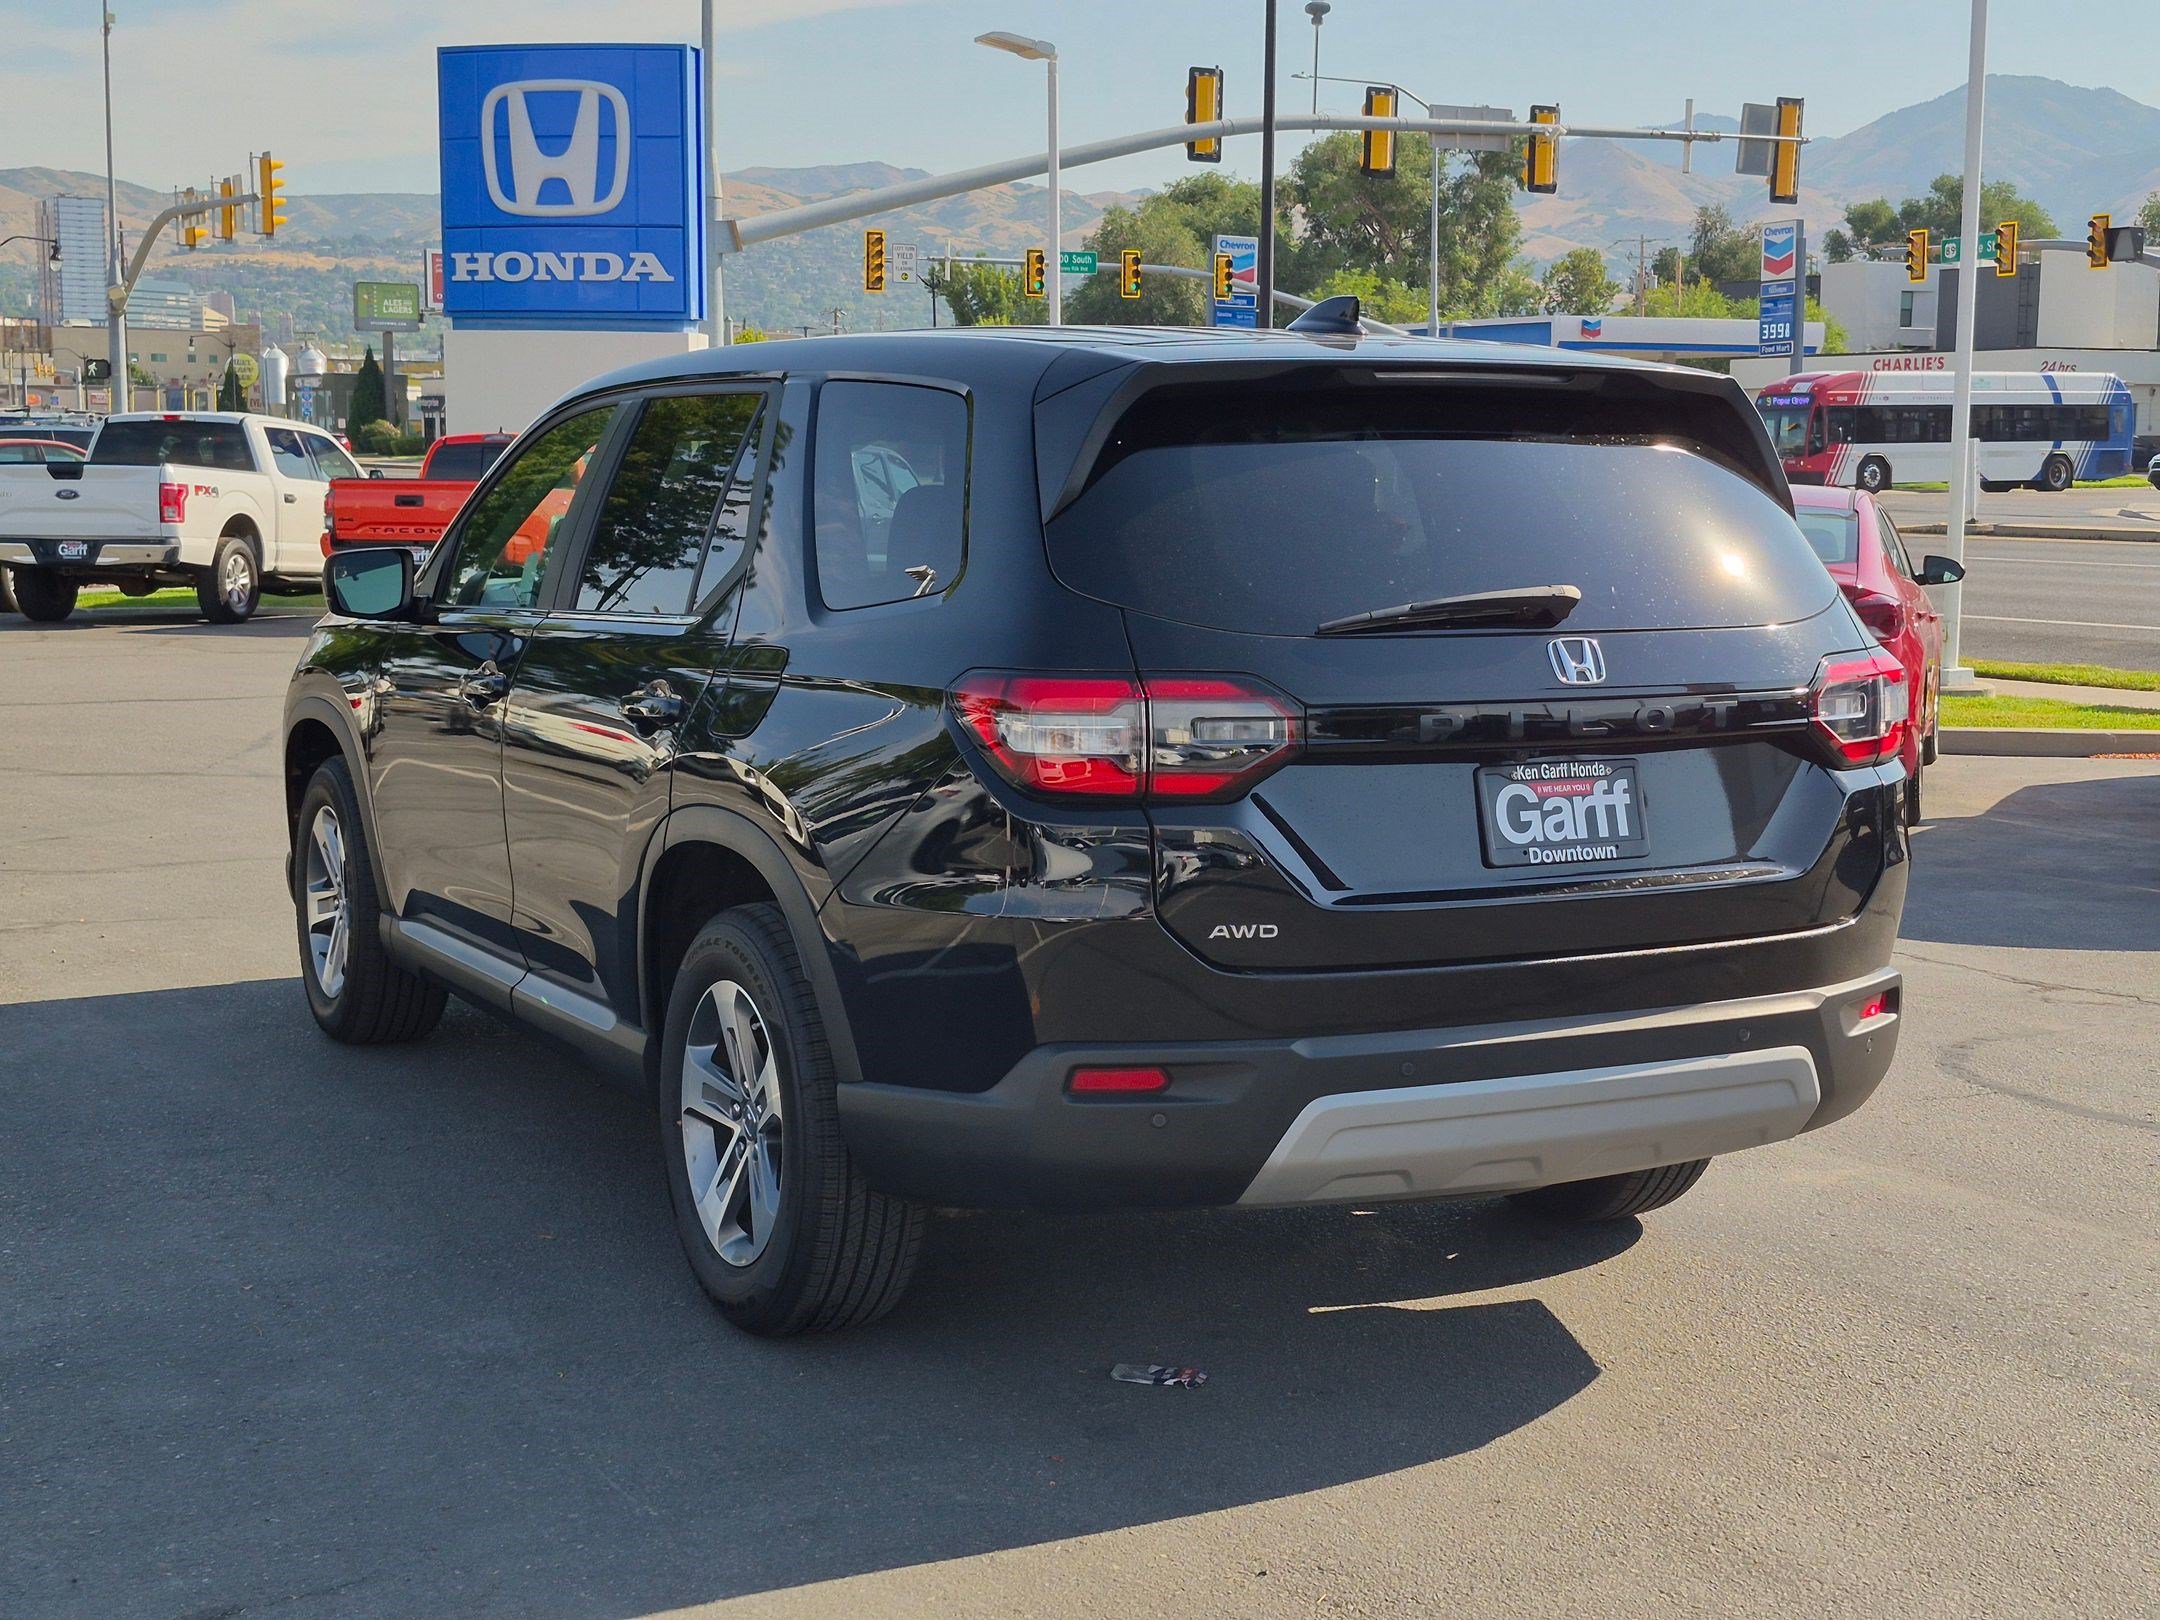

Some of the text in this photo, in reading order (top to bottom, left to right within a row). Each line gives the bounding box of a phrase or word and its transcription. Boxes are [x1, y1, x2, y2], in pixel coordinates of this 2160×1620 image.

[1220, 240, 1255, 250] Chevron
[1072, 254, 1092, 264] South
[451, 251, 675, 282] HONDA
[1776, 344, 1791, 352] Mart
[1873, 356, 1945, 372] CHARLIE'S
[2040, 360, 2057, 372] 24
[194, 485, 220, 498] FX4
[58, 543, 88, 556] Garff
[1419, 699, 1738, 743] PILOT
[1517, 761, 1606, 780] Ken Garff Honda
[1553, 785, 1571, 793] HEAR
[1572, 784, 1585, 792] YOU
[1495, 778, 1630, 845] Garff
[1528, 844, 1617, 864] Downtown
[1208, 924, 1279, 939] AWD
